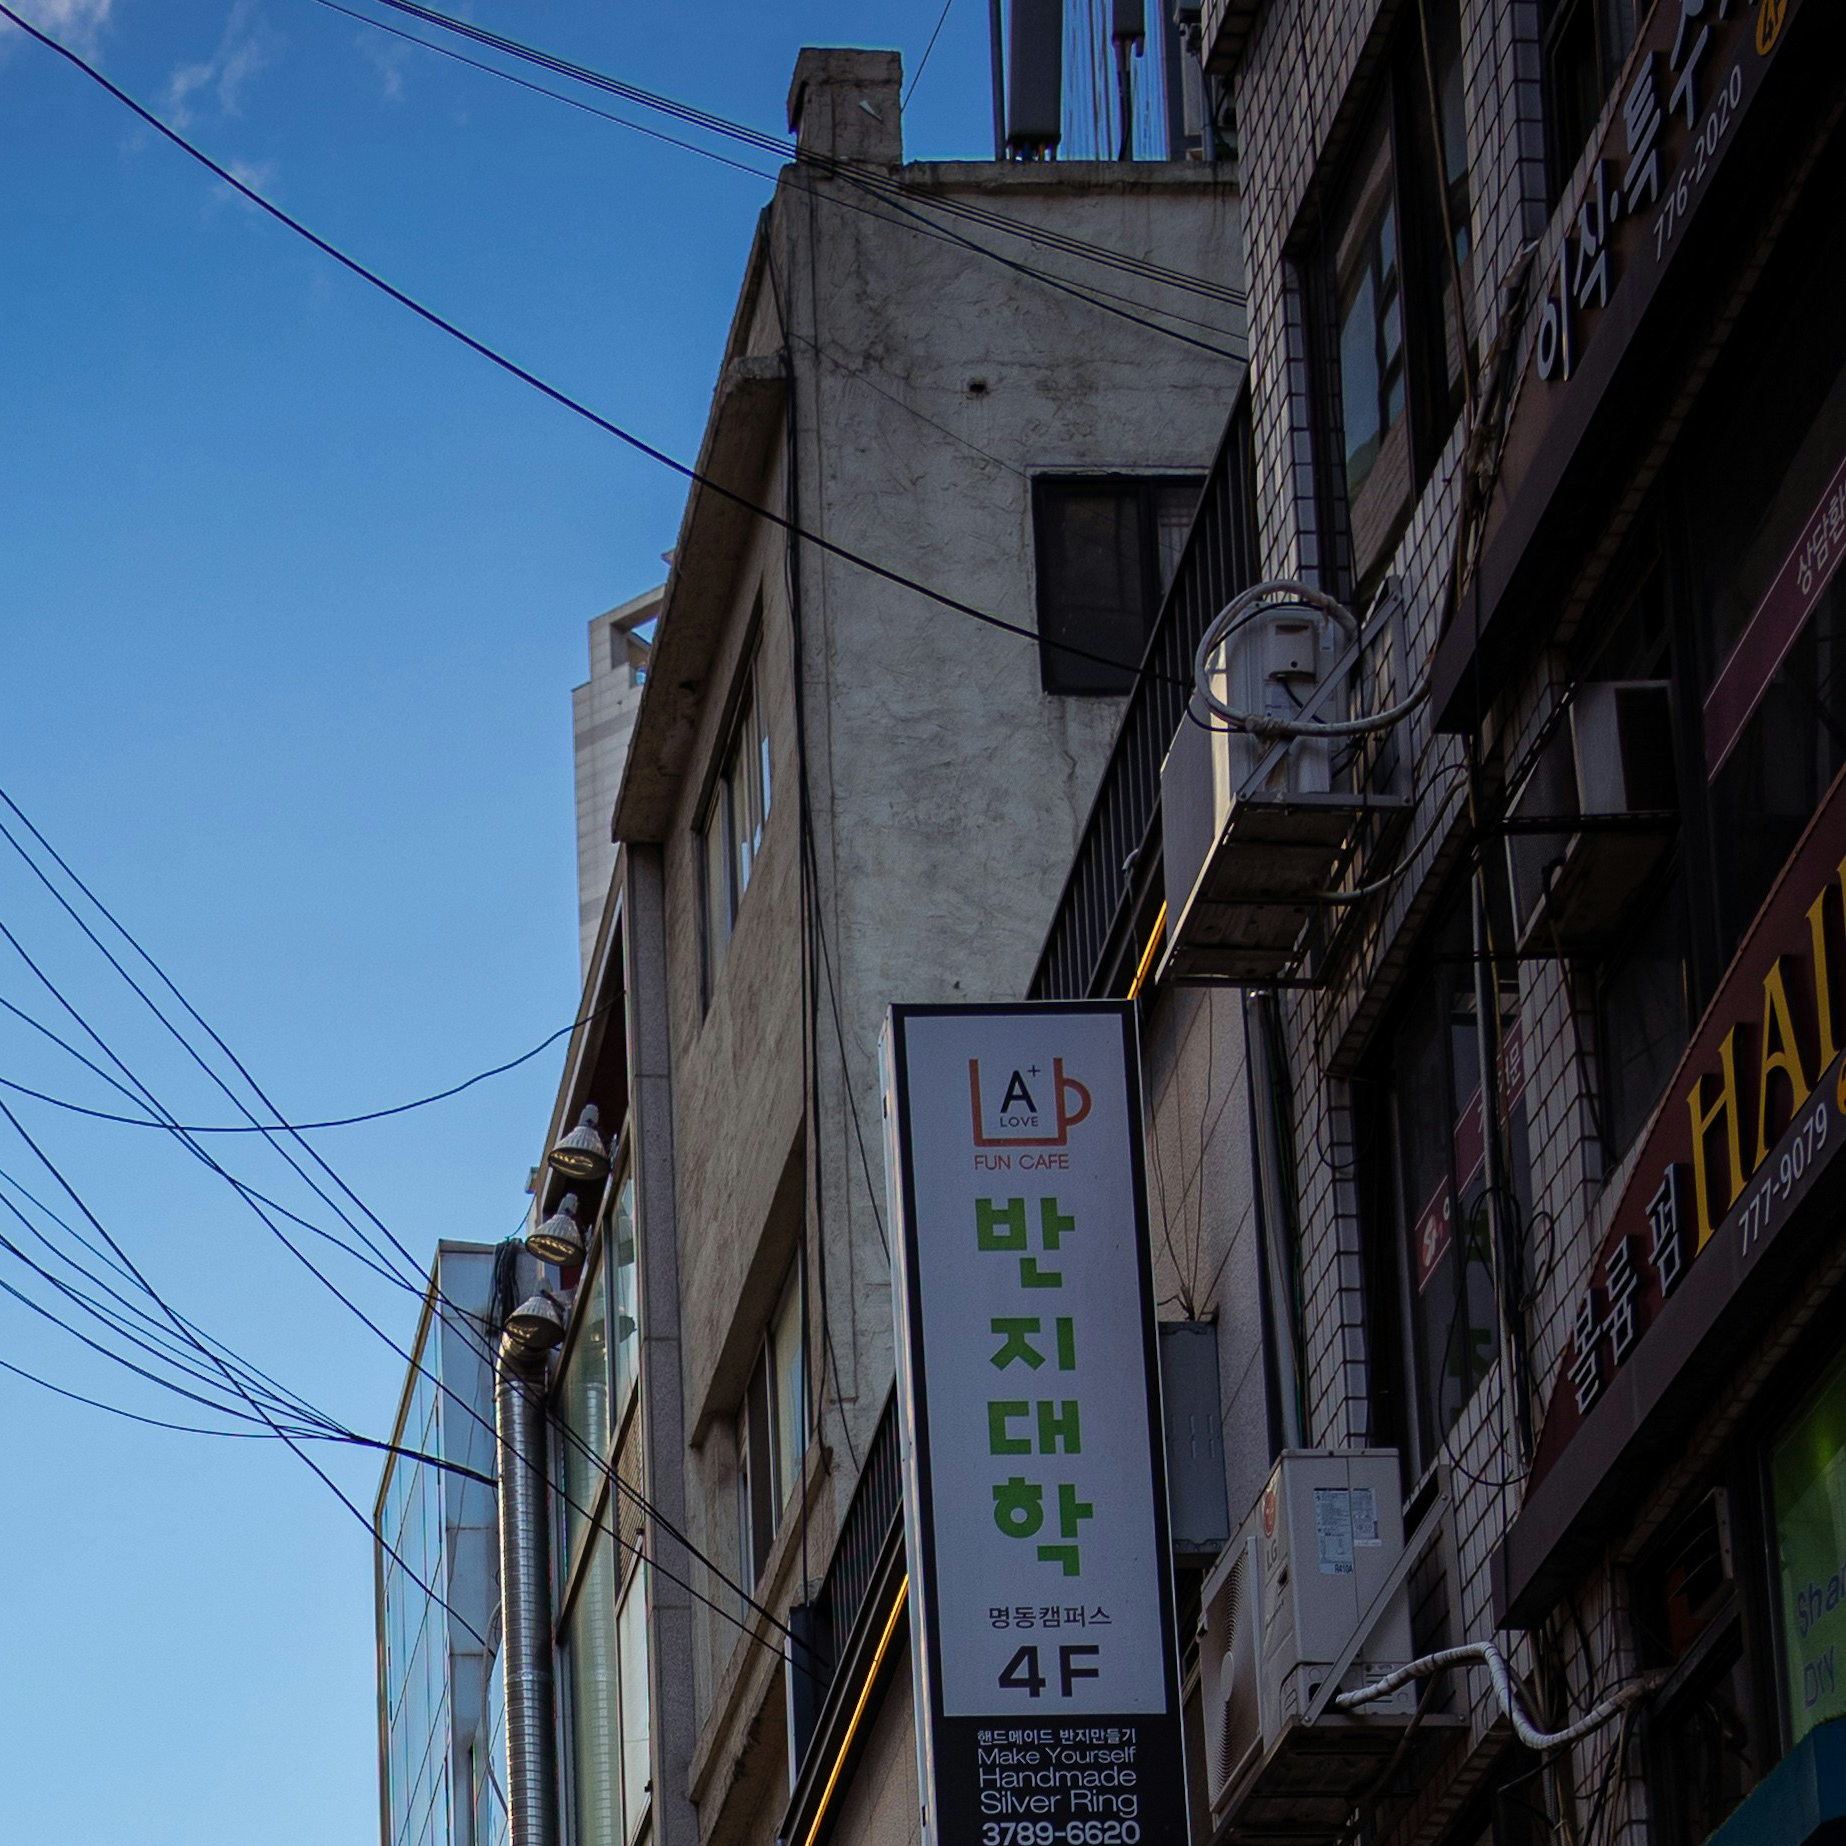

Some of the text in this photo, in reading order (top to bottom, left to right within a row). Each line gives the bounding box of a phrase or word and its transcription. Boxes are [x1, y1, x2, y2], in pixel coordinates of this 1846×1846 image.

[1654, 65, 1743, 263] 776-2020
[999, 1115, 1040, 1127] LOVE
[975, 1154, 1070, 1169] FUN CAFE
[1739, 1102, 1828, 1258] 777-9079
[977, 1196, 1093, 1577] 반지대학
[988, 1606, 1113, 1630] 명동캠퍼스
[998, 1644, 1100, 1697] 4F
[977, 1728, 1137, 1745] 핸드메이드 반지만들기
[977, 1745, 1137, 1765] Make Yourself
[979, 1766, 1137, 1787] Handmade
[980, 1790, 1139, 1820] Silver Ring
[981, 1822, 1141, 1846] 3789-6620
